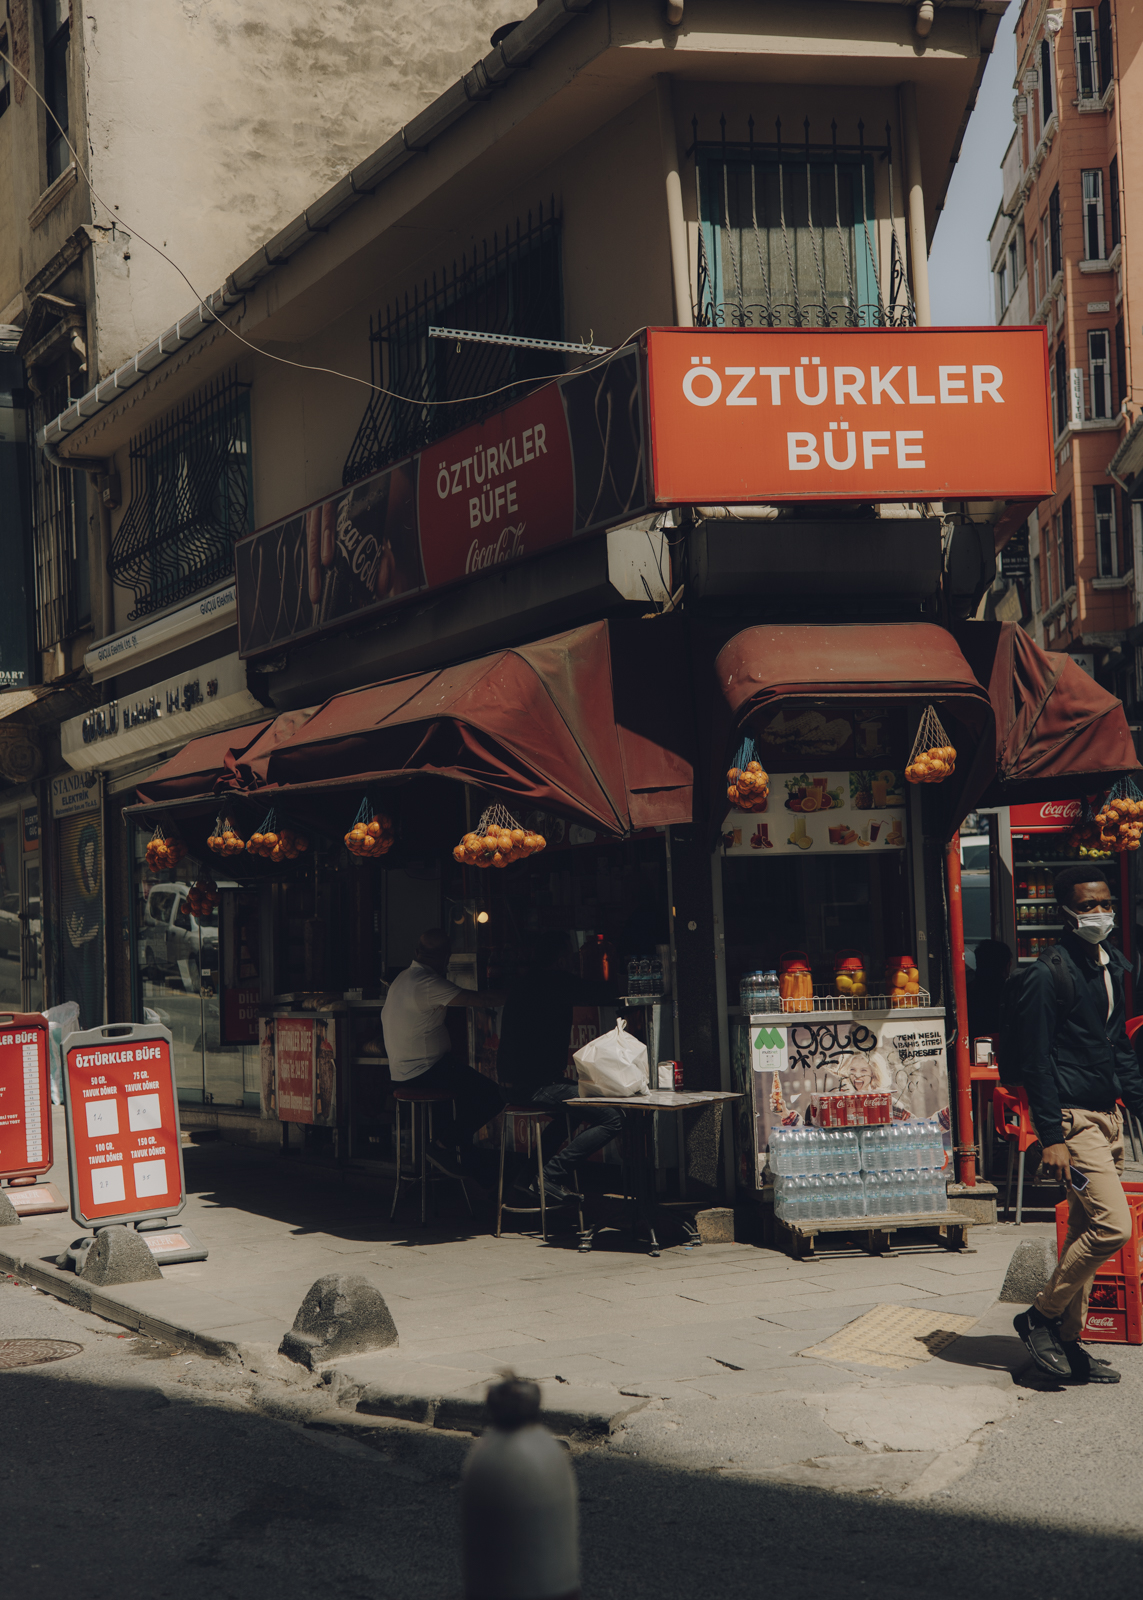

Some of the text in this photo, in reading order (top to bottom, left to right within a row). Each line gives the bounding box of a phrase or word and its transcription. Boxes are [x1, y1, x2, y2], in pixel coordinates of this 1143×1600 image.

[681, 356, 1006, 408] ÖZTÜRKLER
[786, 421, 927, 472] BÜFE
[436, 422, 549, 500] ÖZTÜRKLER
[468, 480, 520, 529] BÜFE
[62, 790, 90, 806] ELEKTRİK
[15, 1032, 38, 1045] BÜFE
[76, 1046, 162, 1069] ÖZTÜRKLER BÜFE
[91, 1075, 108, 1086] 50 GR.
[133, 1070, 150, 1081] 75 GR.
[83, 1085, 119, 1098] TAVUK DÖNER
[125, 1080, 161, 1093] TAVUK DÖNER
[95, 1142, 115, 1153] 100 GR.
[137, 1136, 157, 1147] 150 GR.
[88, 1152, 123, 1165] TAVUK DÖNER
[130, 1146, 166, 1160] TAVUK DÖNER
